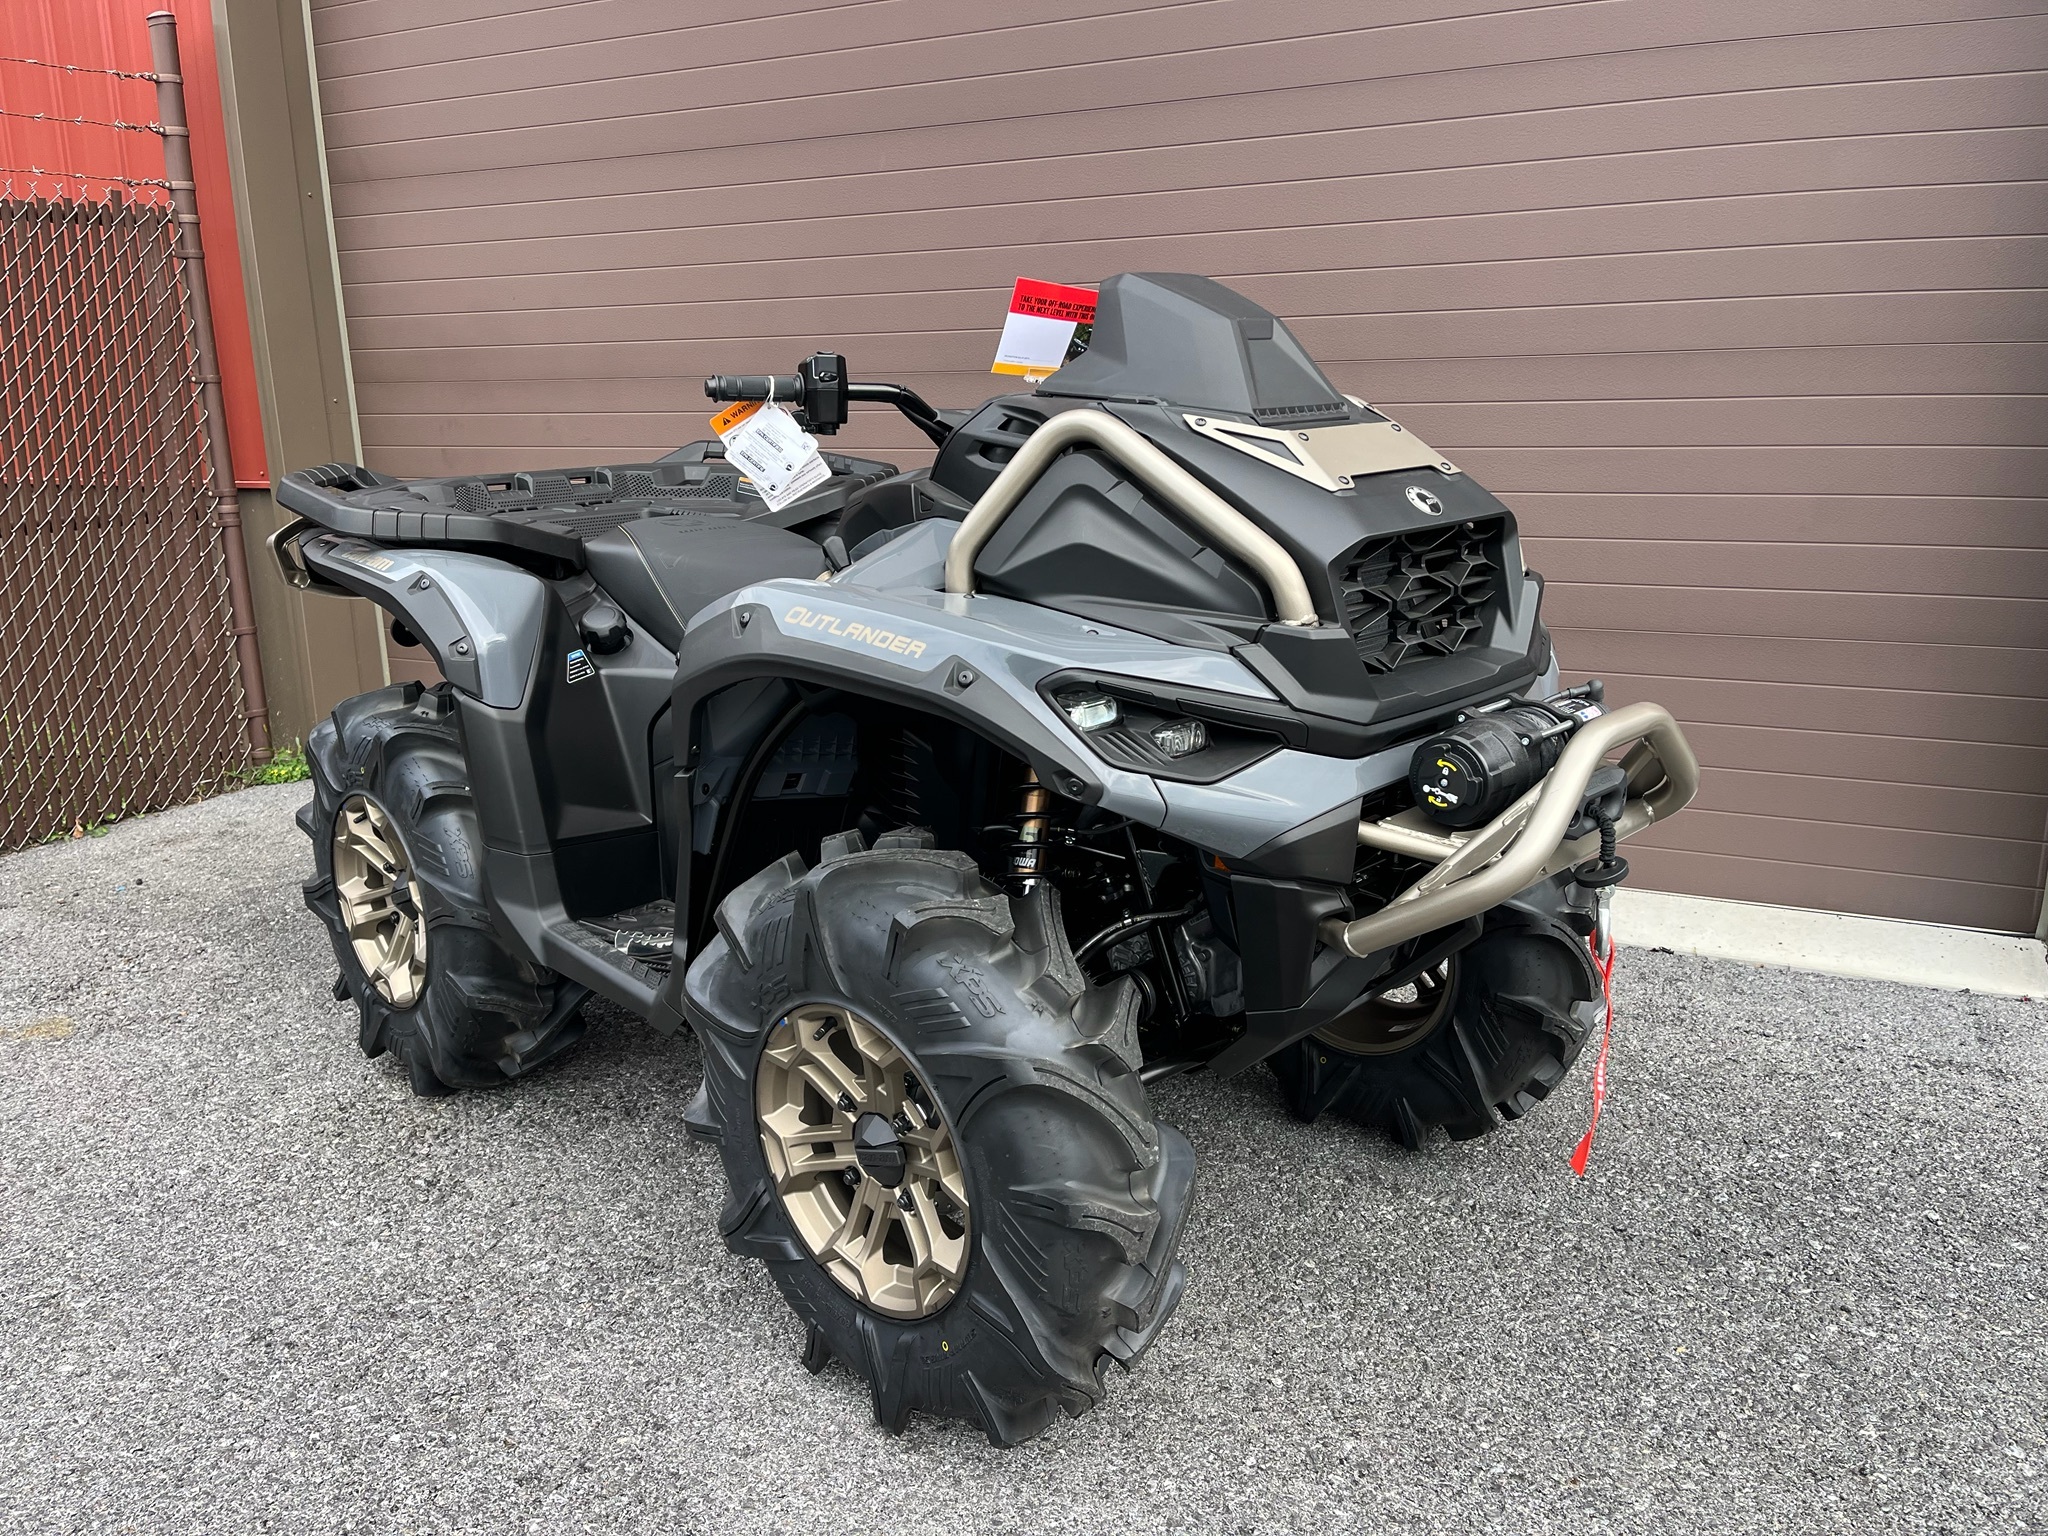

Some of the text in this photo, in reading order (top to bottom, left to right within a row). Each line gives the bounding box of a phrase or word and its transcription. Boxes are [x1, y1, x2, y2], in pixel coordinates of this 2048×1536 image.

[1020, 295, 1033, 304] TAKE
[1034, 296, 1048, 306] YOUR
[1018, 303, 1026, 311] TO
[1026, 304, 1035, 313] THE
[1036, 305, 1050, 314] NEXT
[1050, 307, 1064, 317] LEVEL
[784, 606, 927, 659] OUTLANDER
